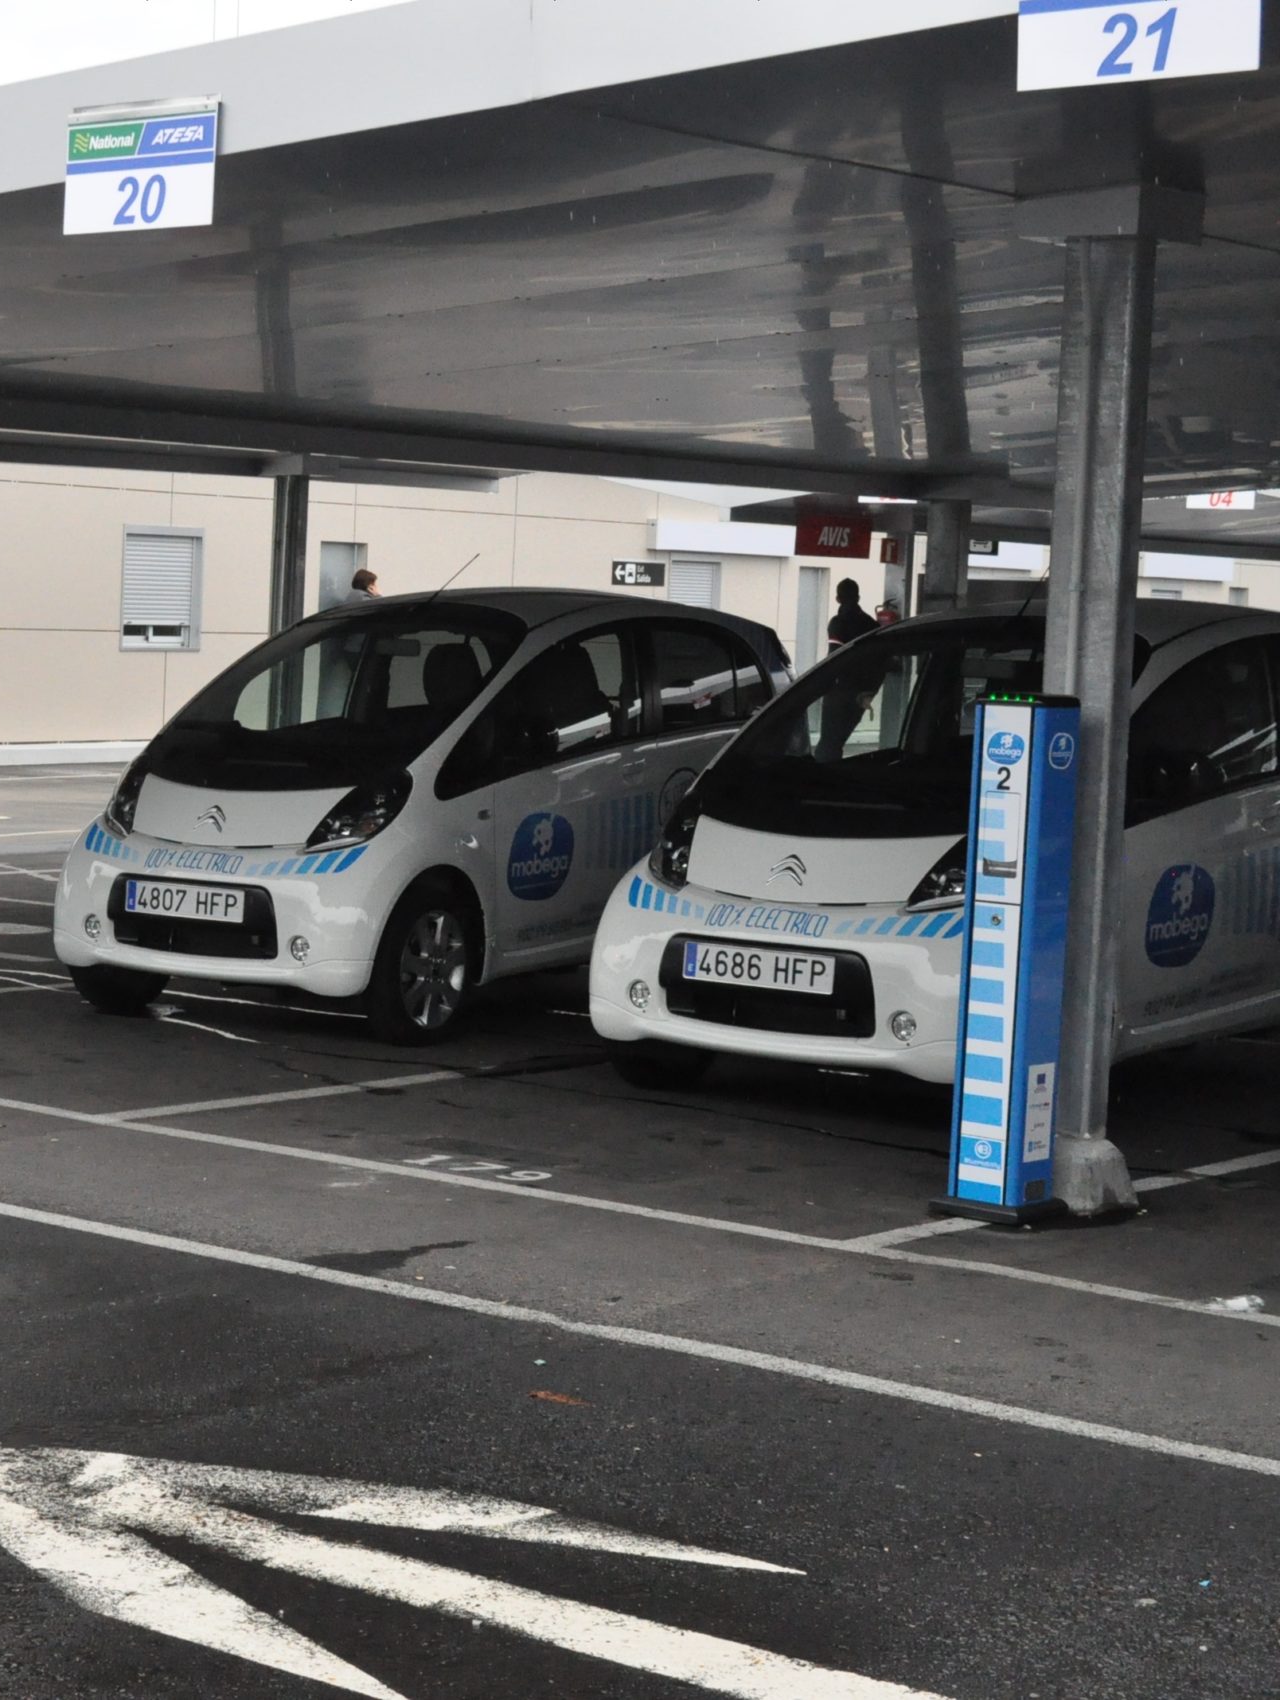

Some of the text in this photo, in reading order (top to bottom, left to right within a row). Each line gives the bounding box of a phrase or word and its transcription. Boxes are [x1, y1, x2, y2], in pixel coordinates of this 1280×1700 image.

[1096, 7, 1177, 77] 21
[88, 125, 204, 150] National ATESA
[113, 174, 166, 225] 20
[1209, 490, 1233, 507] 04
[817, 526, 851, 548] AVIS
[988, 746, 1022, 758] mobega
[996, 766, 1011, 790] 2
[144, 848, 244, 875] 100% ELECTRICO
[511, 854, 569, 877] mobega
[137, 886, 187, 912] 4807
[195, 890, 237, 917] HFP
[704, 903, 829, 938] 100% ELECTRICO
[1149, 911, 1209, 941] mobega
[699, 948, 762, 981] 4686
[773, 955, 826, 987] HFP
[402, 1154, 552, 1182] 179
